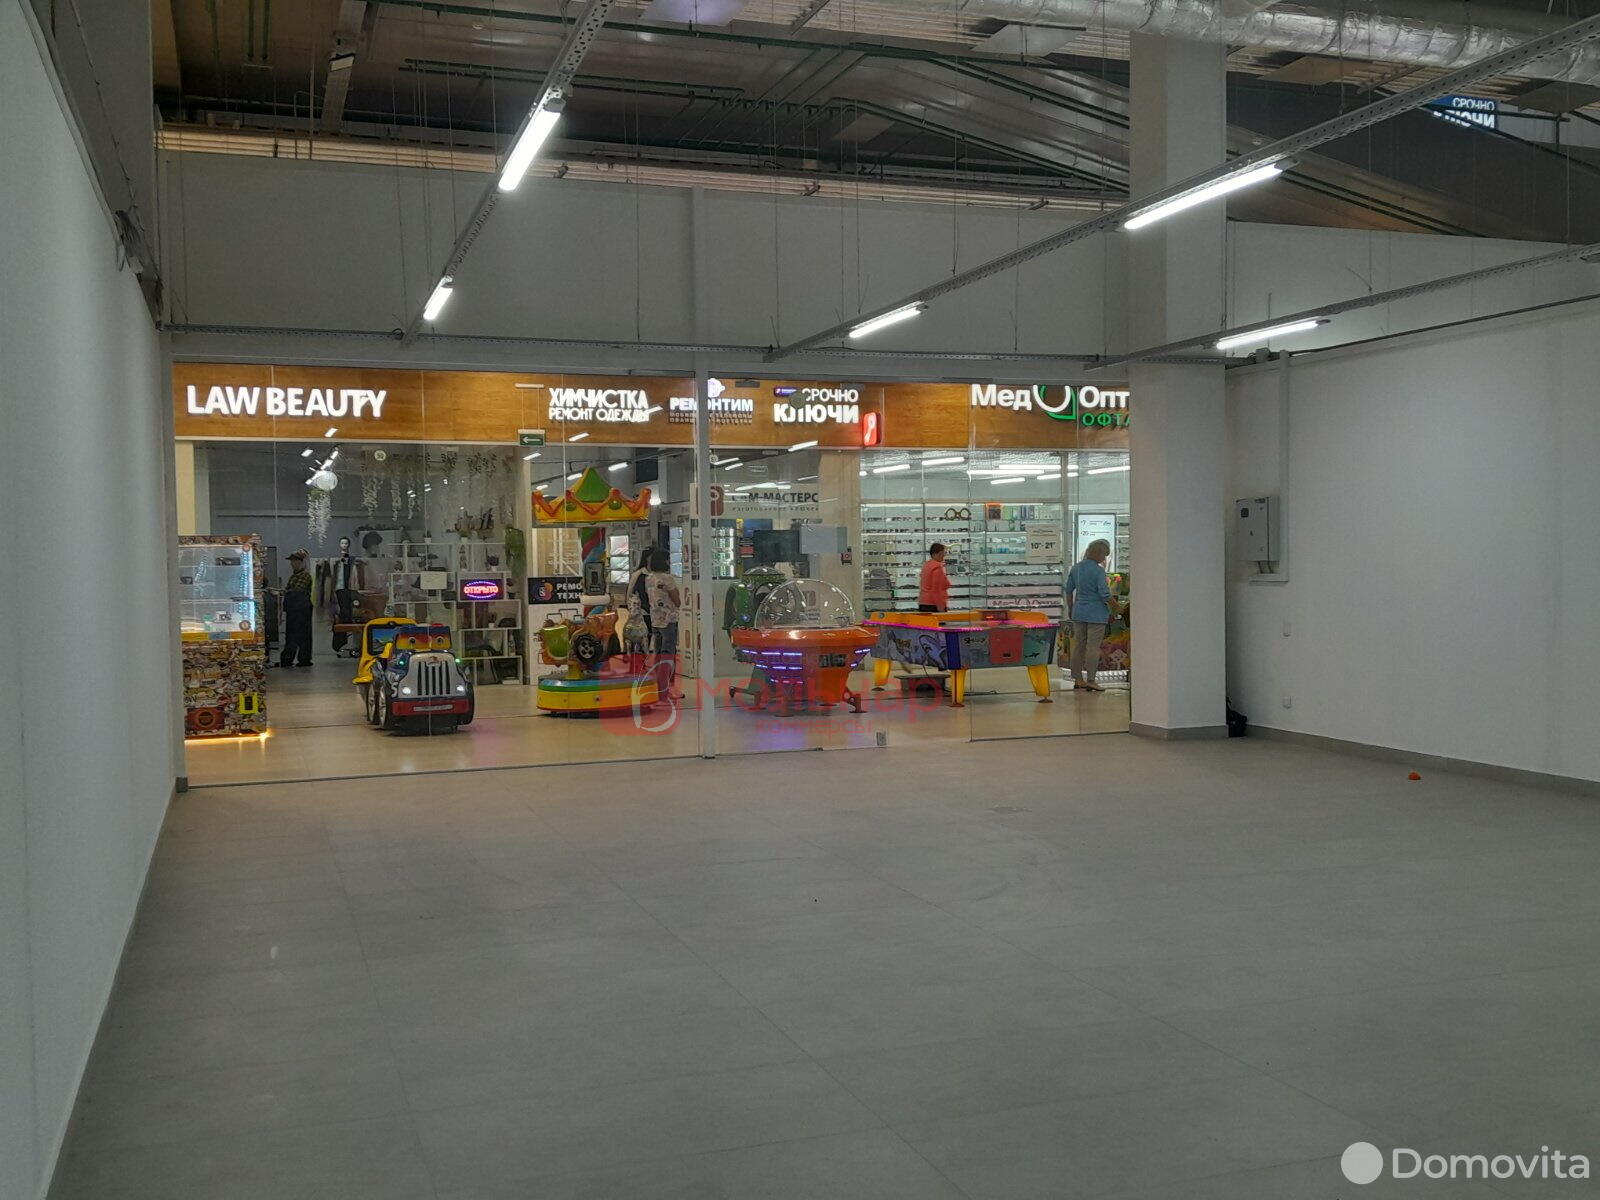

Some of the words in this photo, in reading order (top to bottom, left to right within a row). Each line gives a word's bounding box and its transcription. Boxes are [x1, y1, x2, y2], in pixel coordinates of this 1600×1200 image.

[1453, 98, 1494, 110] СРОЧНО
[187, 385, 260, 415] LAW
[266, 387, 387, 417] BEAUTY
[549, 388, 649, 409] ХИМЧИСТКА
[802, 388, 859, 402] СРОЧНО
[971, 384, 1032, 411] Мед
[549, 407, 594, 420] РЕМОНТ
[596, 408, 650, 423] ОДЕЖДЫ
[774, 403, 859, 423] КЛЮЧИ
